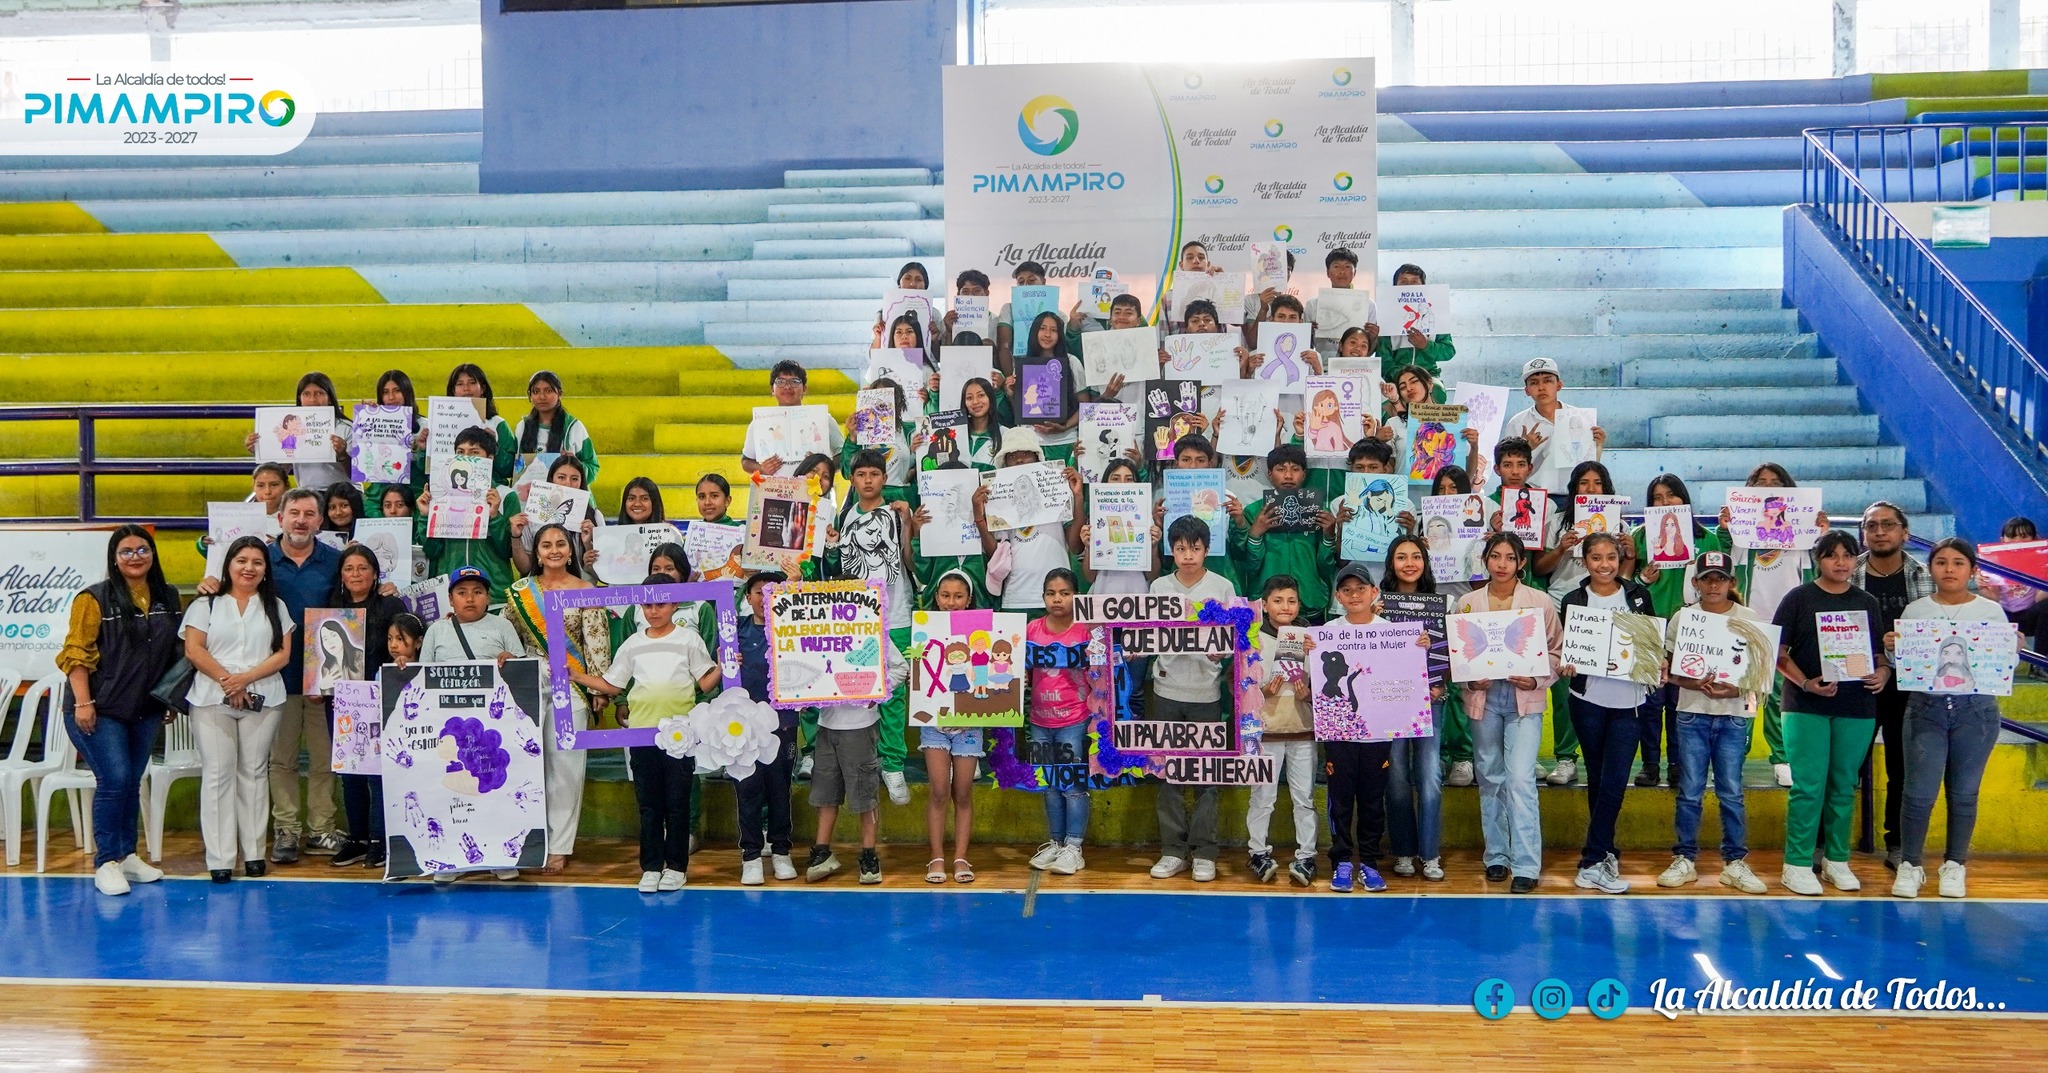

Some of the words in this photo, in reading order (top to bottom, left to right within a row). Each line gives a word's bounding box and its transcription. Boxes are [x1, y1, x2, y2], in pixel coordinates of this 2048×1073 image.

[1250, 86, 1262, 95] de
[1264, 86, 1292, 95] Todos!
[1318, 90, 1366, 98] PIMAMPIRO
[1169, 94, 1217, 102] PIMAMPIRO
[1183, 128, 1197, 140] ¡La
[1199, 127, 1237, 138] Alcaldía
[1314, 125, 1329, 137] ¡La
[1329, 124, 1369, 135] Alcaldía
[1191, 137, 1202, 147] de
[1204, 137, 1232, 146] Todos!
[1322, 134, 1334, 143] de
[1336, 133, 1364, 143] Todos!
[1250, 142, 1298, 150] PIMAMPIRO
[1022, 163, 1051, 171] Alcaldía
[973, 172, 1125, 193] PIMAMPIRO
[1253, 181, 1267, 193] ¡La
[1269, 180, 1307, 191] Alcaldía
[1029, 195, 1070, 204] 2023-2027
[1191, 197, 1238, 206] PIMAMPIRO
[1261, 190, 1272, 200] de
[1274, 190, 1302, 199] Todos!
[1319, 195, 1367, 203] PIMAMPIRO
[1211, 233, 1250, 243] Alcaldía
[1317, 232, 1331, 244] ¡La
[1332, 231, 1371, 242] Alcaldía
[1216, 242, 1246, 251] Todos!
[1325, 241, 1336, 250] de
[1338, 240, 1367, 249] Todos!
[995, 243, 1024, 266] ¡La
[1028, 241, 1107, 263] Alcaldía
[1576, 496, 1588, 505] NO
[7, 590, 73, 614] Todos!
[552, 590, 569, 611] No
[572, 593, 601, 608] violencia
[605, 589, 628, 606] contra
[631, 587, 640, 604] la
[643, 586, 671, 603] Mujer
[792, 591, 882, 616] INTERNACIONAL
[792, 609, 805, 621] DE
[810, 607, 826, 620] LA
[832, 604, 857, 621] NO
[1074, 597, 1094, 621] NI
[1103, 596, 1183, 621] GOLPES
[1692, 614, 1707, 623] NO
[1821, 614, 1833, 623] NO
[1835, 614, 1846, 622] AL
[773, 623, 831, 637] VIOLENCIA
[833, 622, 882, 635] CONTRA
[1318, 630, 1334, 641] Día
[1339, 630, 1351, 640] de
[1355, 629, 1363, 639] la
[1366, 630, 1377, 639] no
[1379, 628, 1421, 638] violencia
[1681, 626, 1706, 639] MAS
[778, 639, 795, 652] LA
[800, 636, 853, 653] MUJER
[1120, 628, 1155, 653] QUE
[1158, 626, 1235, 653] DUELAN
[1337, 642, 1366, 651] contra
[1369, 641, 1378, 650] la
[1380, 640, 1407, 651] Mujer
[1565, 640, 1578, 649] No
[1677, 641, 1724, 656] VIOLENCIA
[1564, 653, 1598, 667] Violencia
[1115, 725, 1131, 748] NI
[1134, 723, 1226, 749] PALABRAS
[1165, 757, 1201, 782] QUE
[1202, 758, 1273, 784] HIERAN
